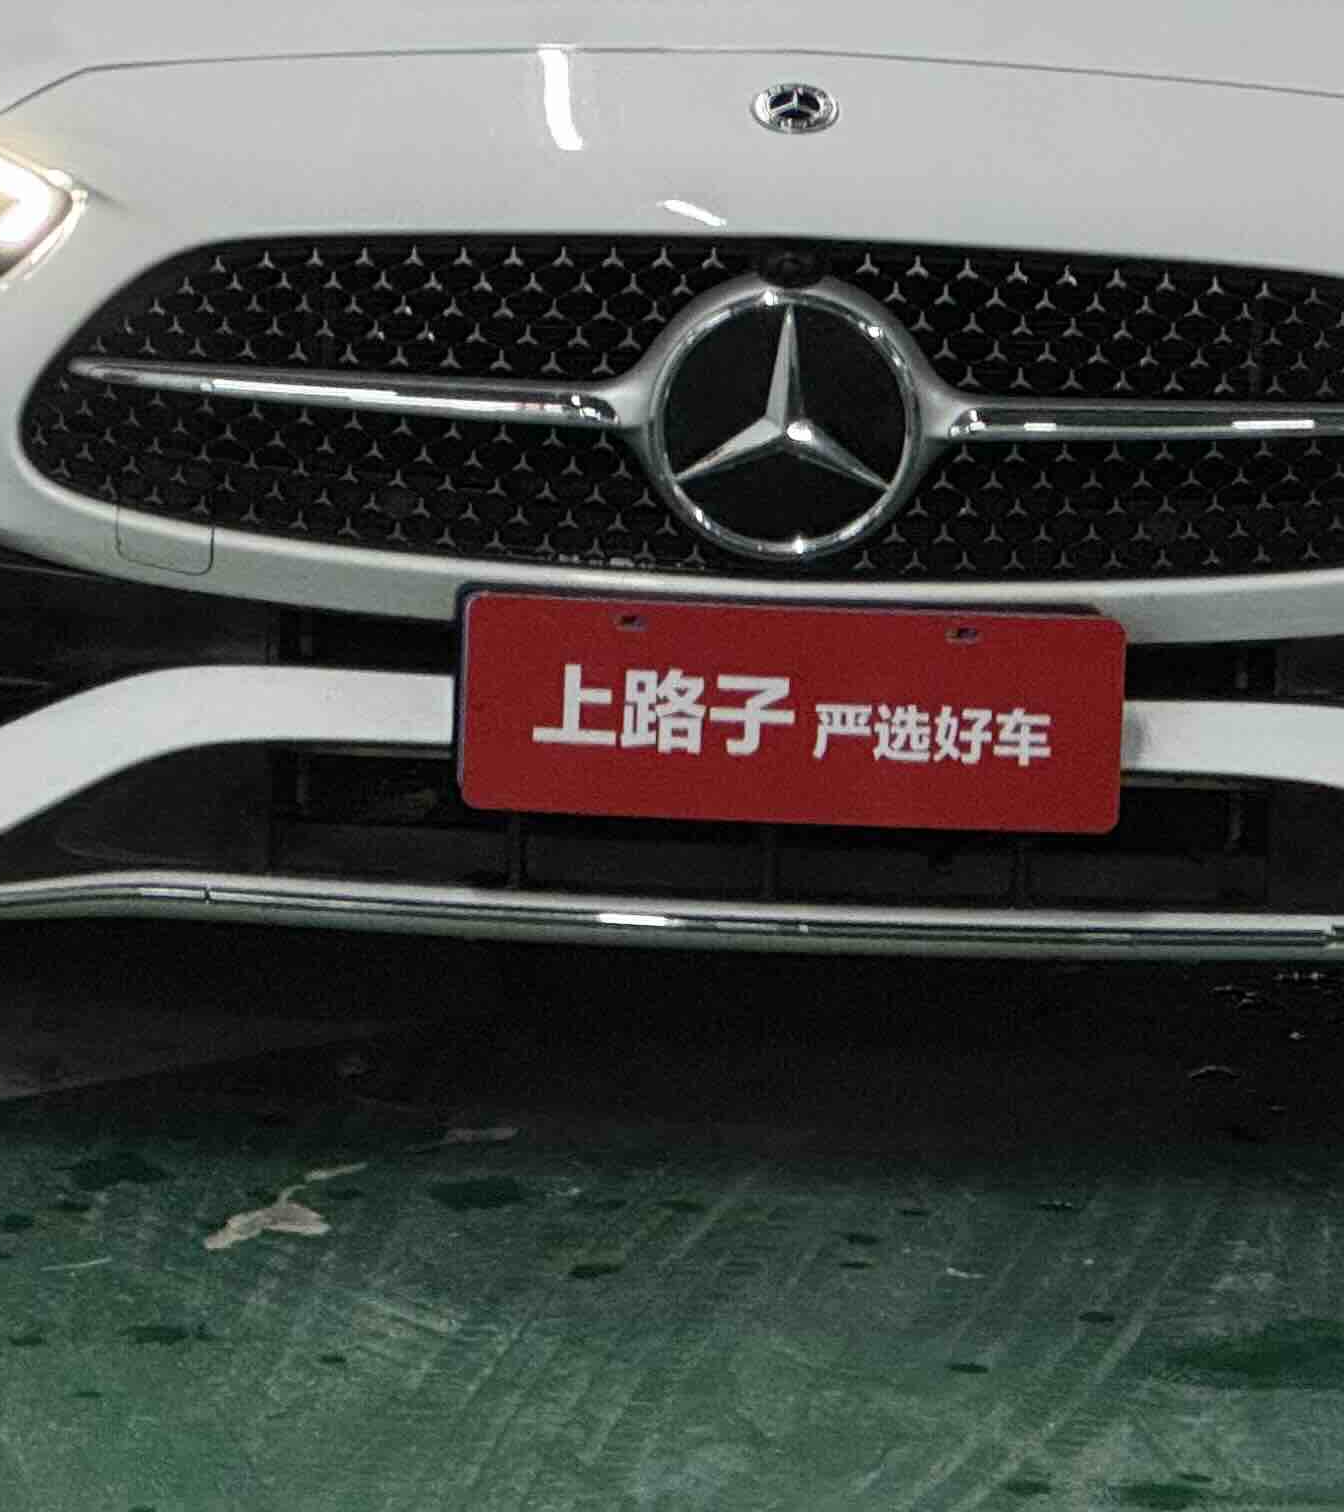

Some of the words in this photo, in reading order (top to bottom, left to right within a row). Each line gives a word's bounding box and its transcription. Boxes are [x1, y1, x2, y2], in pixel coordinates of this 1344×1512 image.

[532, 663, 796, 754] 上路子
[813, 702, 1053, 766] 严选好车
